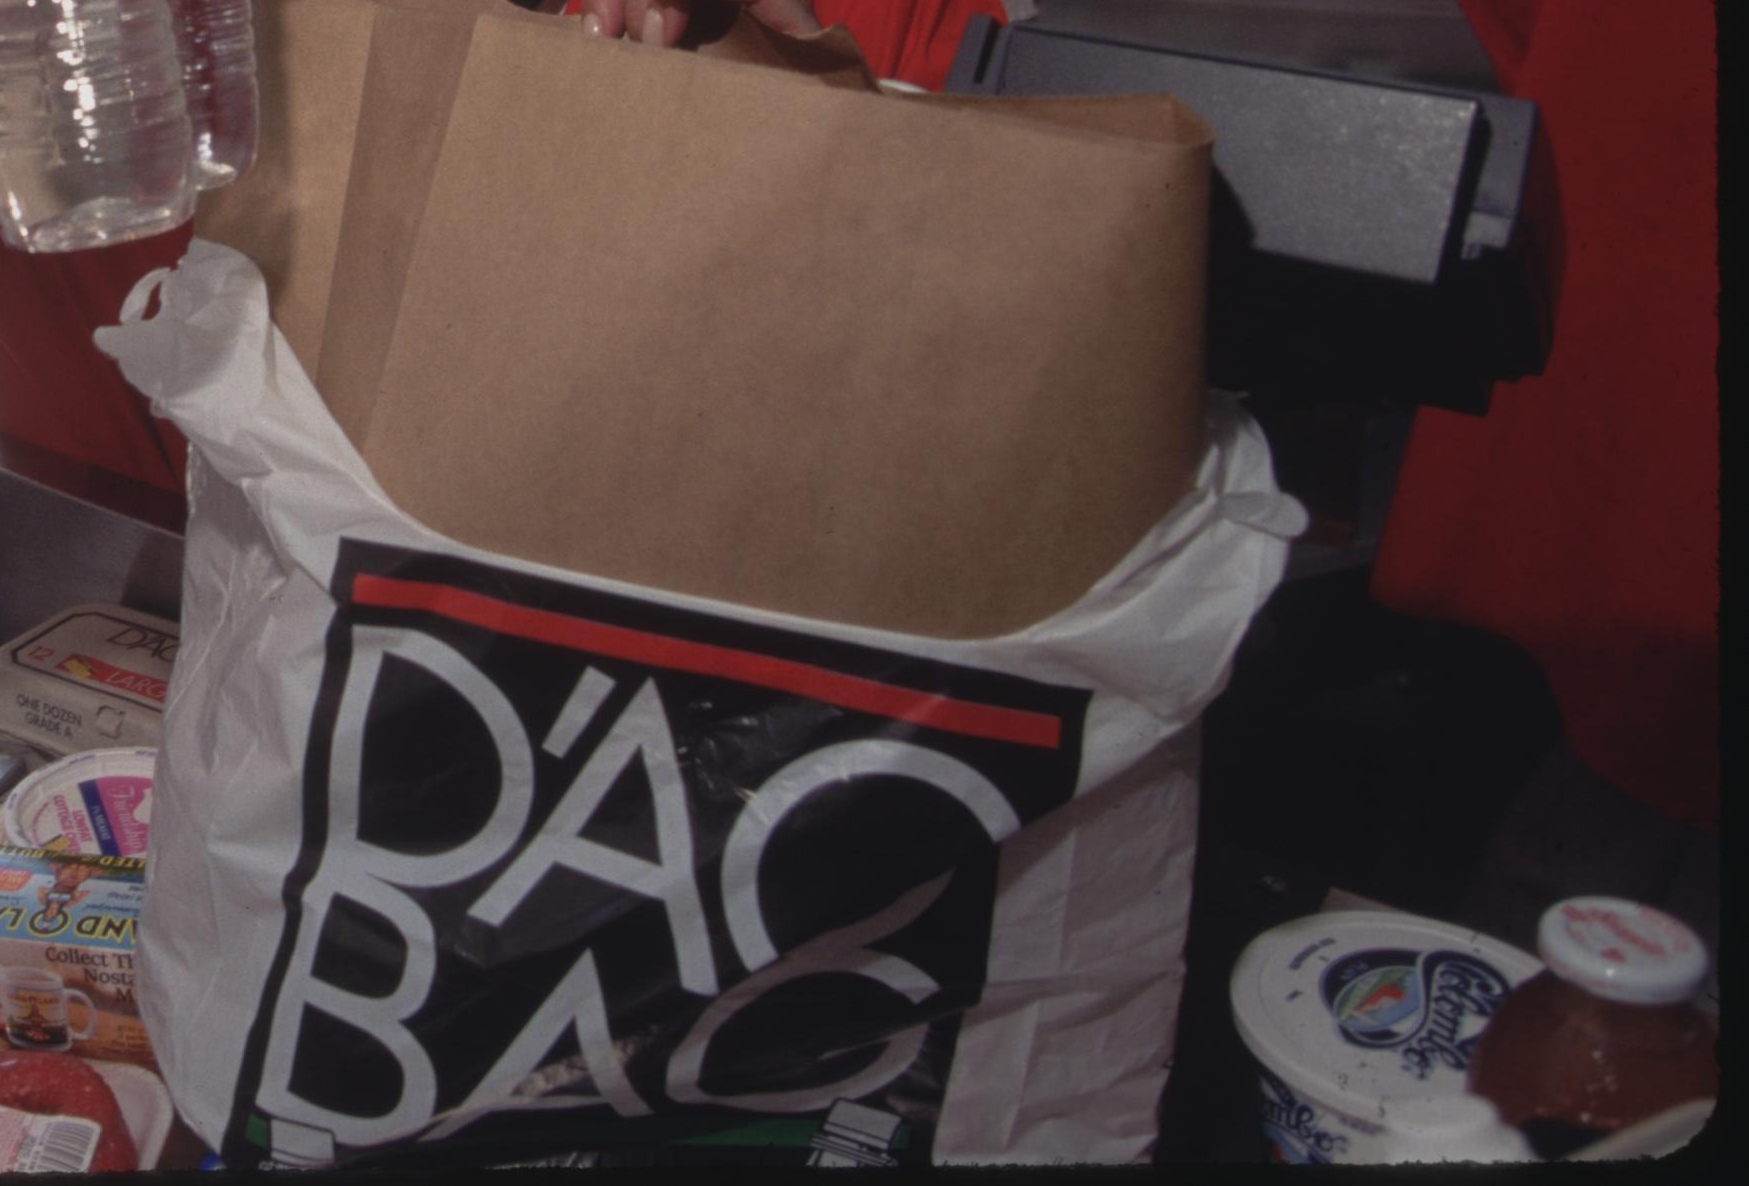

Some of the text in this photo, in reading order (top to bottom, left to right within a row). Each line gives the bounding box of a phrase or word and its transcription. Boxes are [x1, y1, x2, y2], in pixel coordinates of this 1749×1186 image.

[28, 645, 55, 662] 12
[105, 669, 166, 700] LARG
[16, 693, 82, 727] ONE DOZEN
[25, 712, 74, 738] GRADE A
[45, 946, 109, 968] Collect
